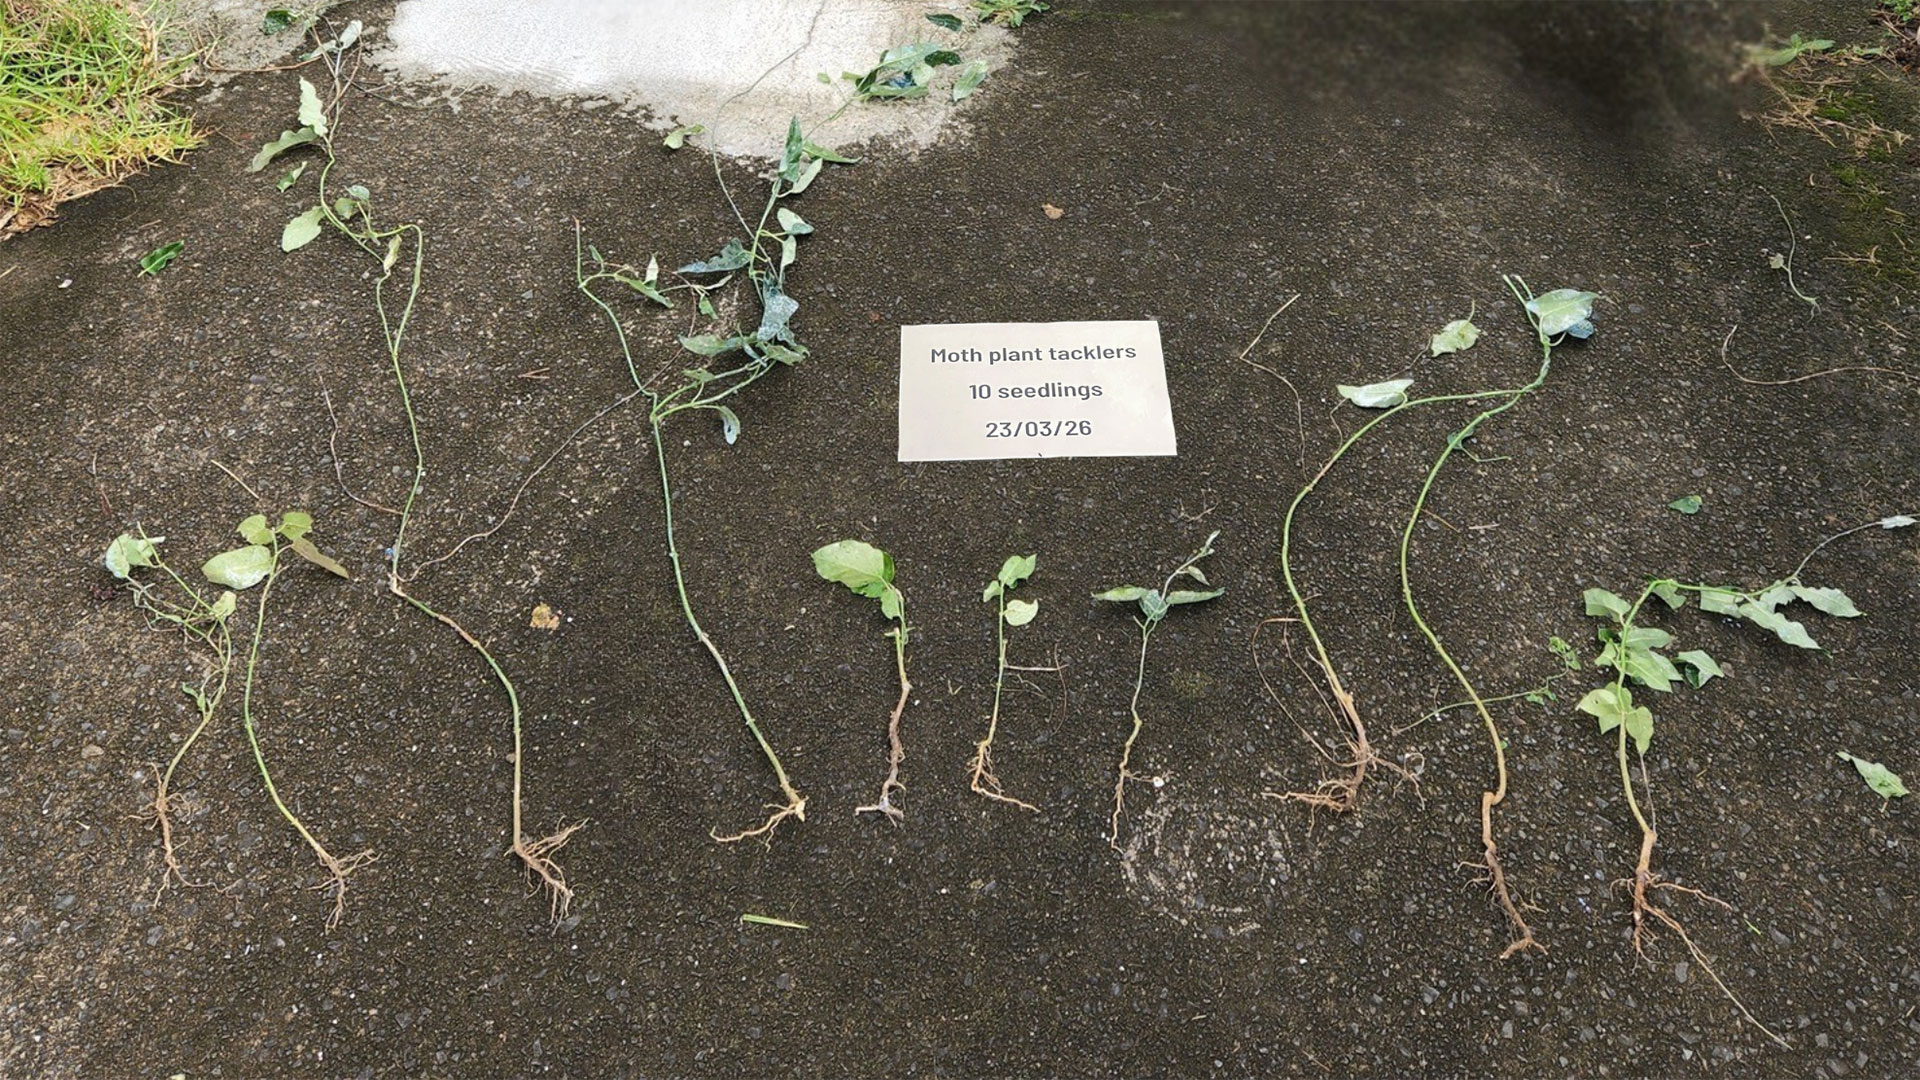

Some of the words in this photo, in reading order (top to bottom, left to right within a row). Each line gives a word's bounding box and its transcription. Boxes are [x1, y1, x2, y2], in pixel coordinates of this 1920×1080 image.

[931, 348, 982, 363] Moth
[989, 347, 1043, 365] plant
[1048, 345, 1137, 361] tacklers
[969, 384, 991, 400] 10
[997, 382, 1103, 401] seedlings
[986, 420, 1092, 438] 23/03/26
